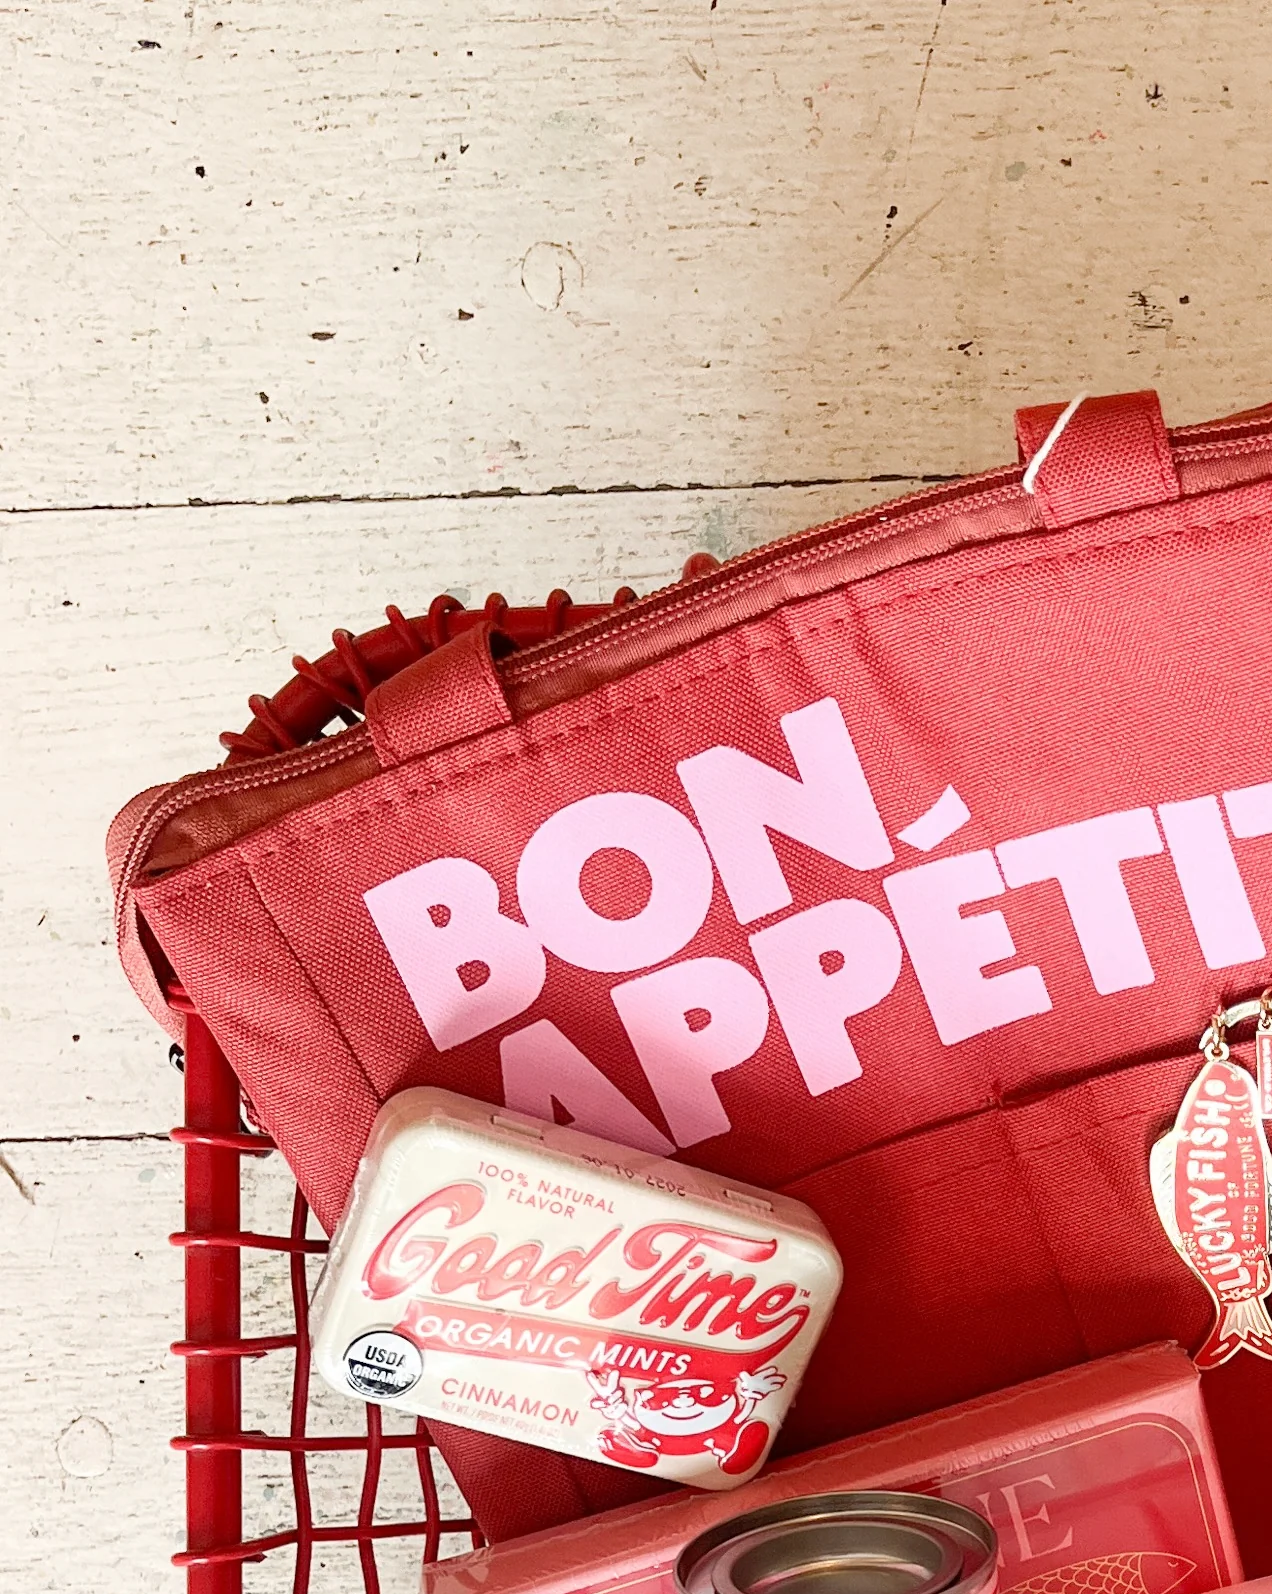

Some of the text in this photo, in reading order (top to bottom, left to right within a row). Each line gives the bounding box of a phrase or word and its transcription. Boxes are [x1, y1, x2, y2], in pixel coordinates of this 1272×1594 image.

[363, 697, 893, 1052] BON
[477, 1160, 615, 1214] 100% NATURAL
[506, 1188, 577, 1220] FLAVOR
[1187, 1100, 1252, 1291] LUCKY FISH
[360, 1180, 624, 1312] Good
[588, 1218, 810, 1342] Time
[364, 1344, 407, 1368] USDA
[414, 1314, 692, 1377] ORGANIC MINTS
[441, 1378, 579, 1428] CINNAMON
